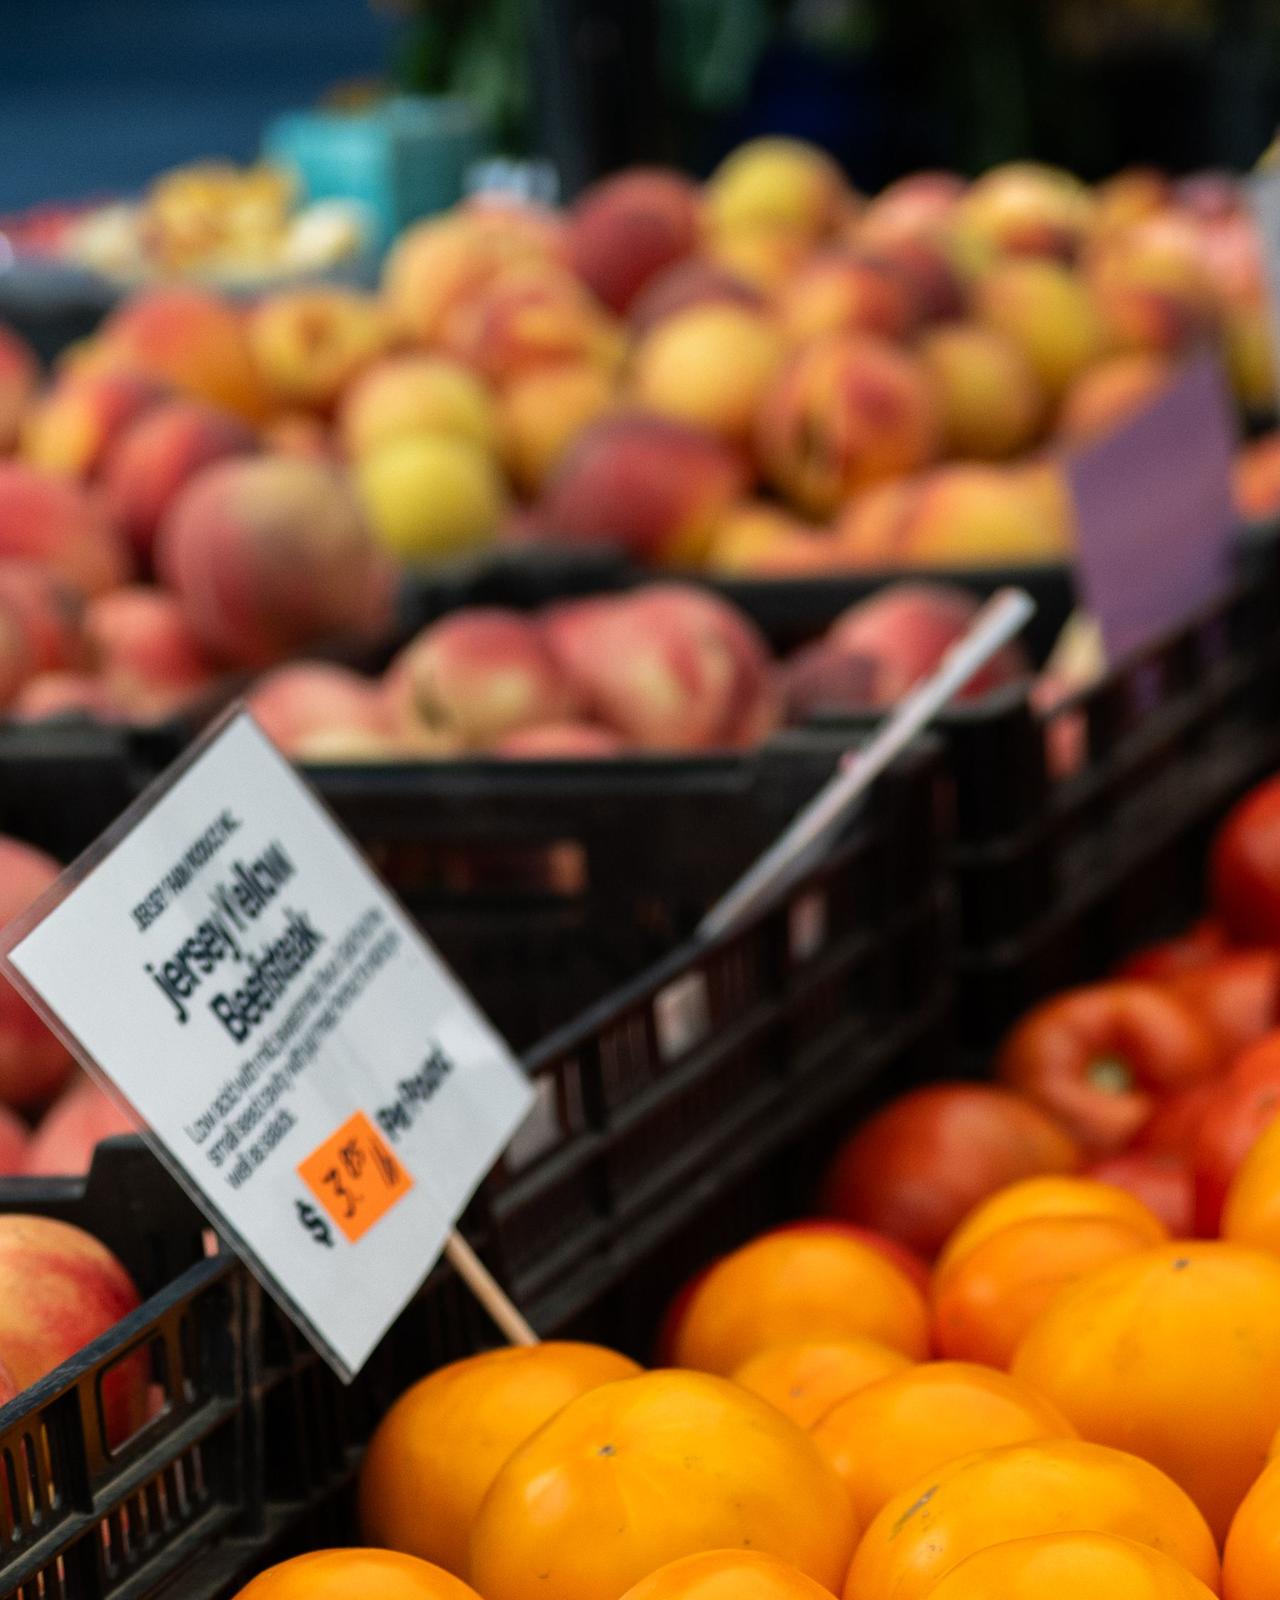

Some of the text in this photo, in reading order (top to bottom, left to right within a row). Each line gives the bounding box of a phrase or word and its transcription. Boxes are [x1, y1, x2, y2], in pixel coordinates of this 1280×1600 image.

[145, 838, 297, 1024] jersey Yellow
[208, 905, 324, 1044] Beefsteak
[184, 1103, 219, 1148] Low
[208, 1079, 240, 1119] acid
[229, 1055, 261, 1095] with
[204, 1122, 242, 1171] small
[231, 1094, 267, 1140] seed
[222, 1151, 254, 1193] well
[246, 1140, 266, 1167] as
[294, 1199, 334, 1247] $
[376, 1100, 412, 1142] Per
